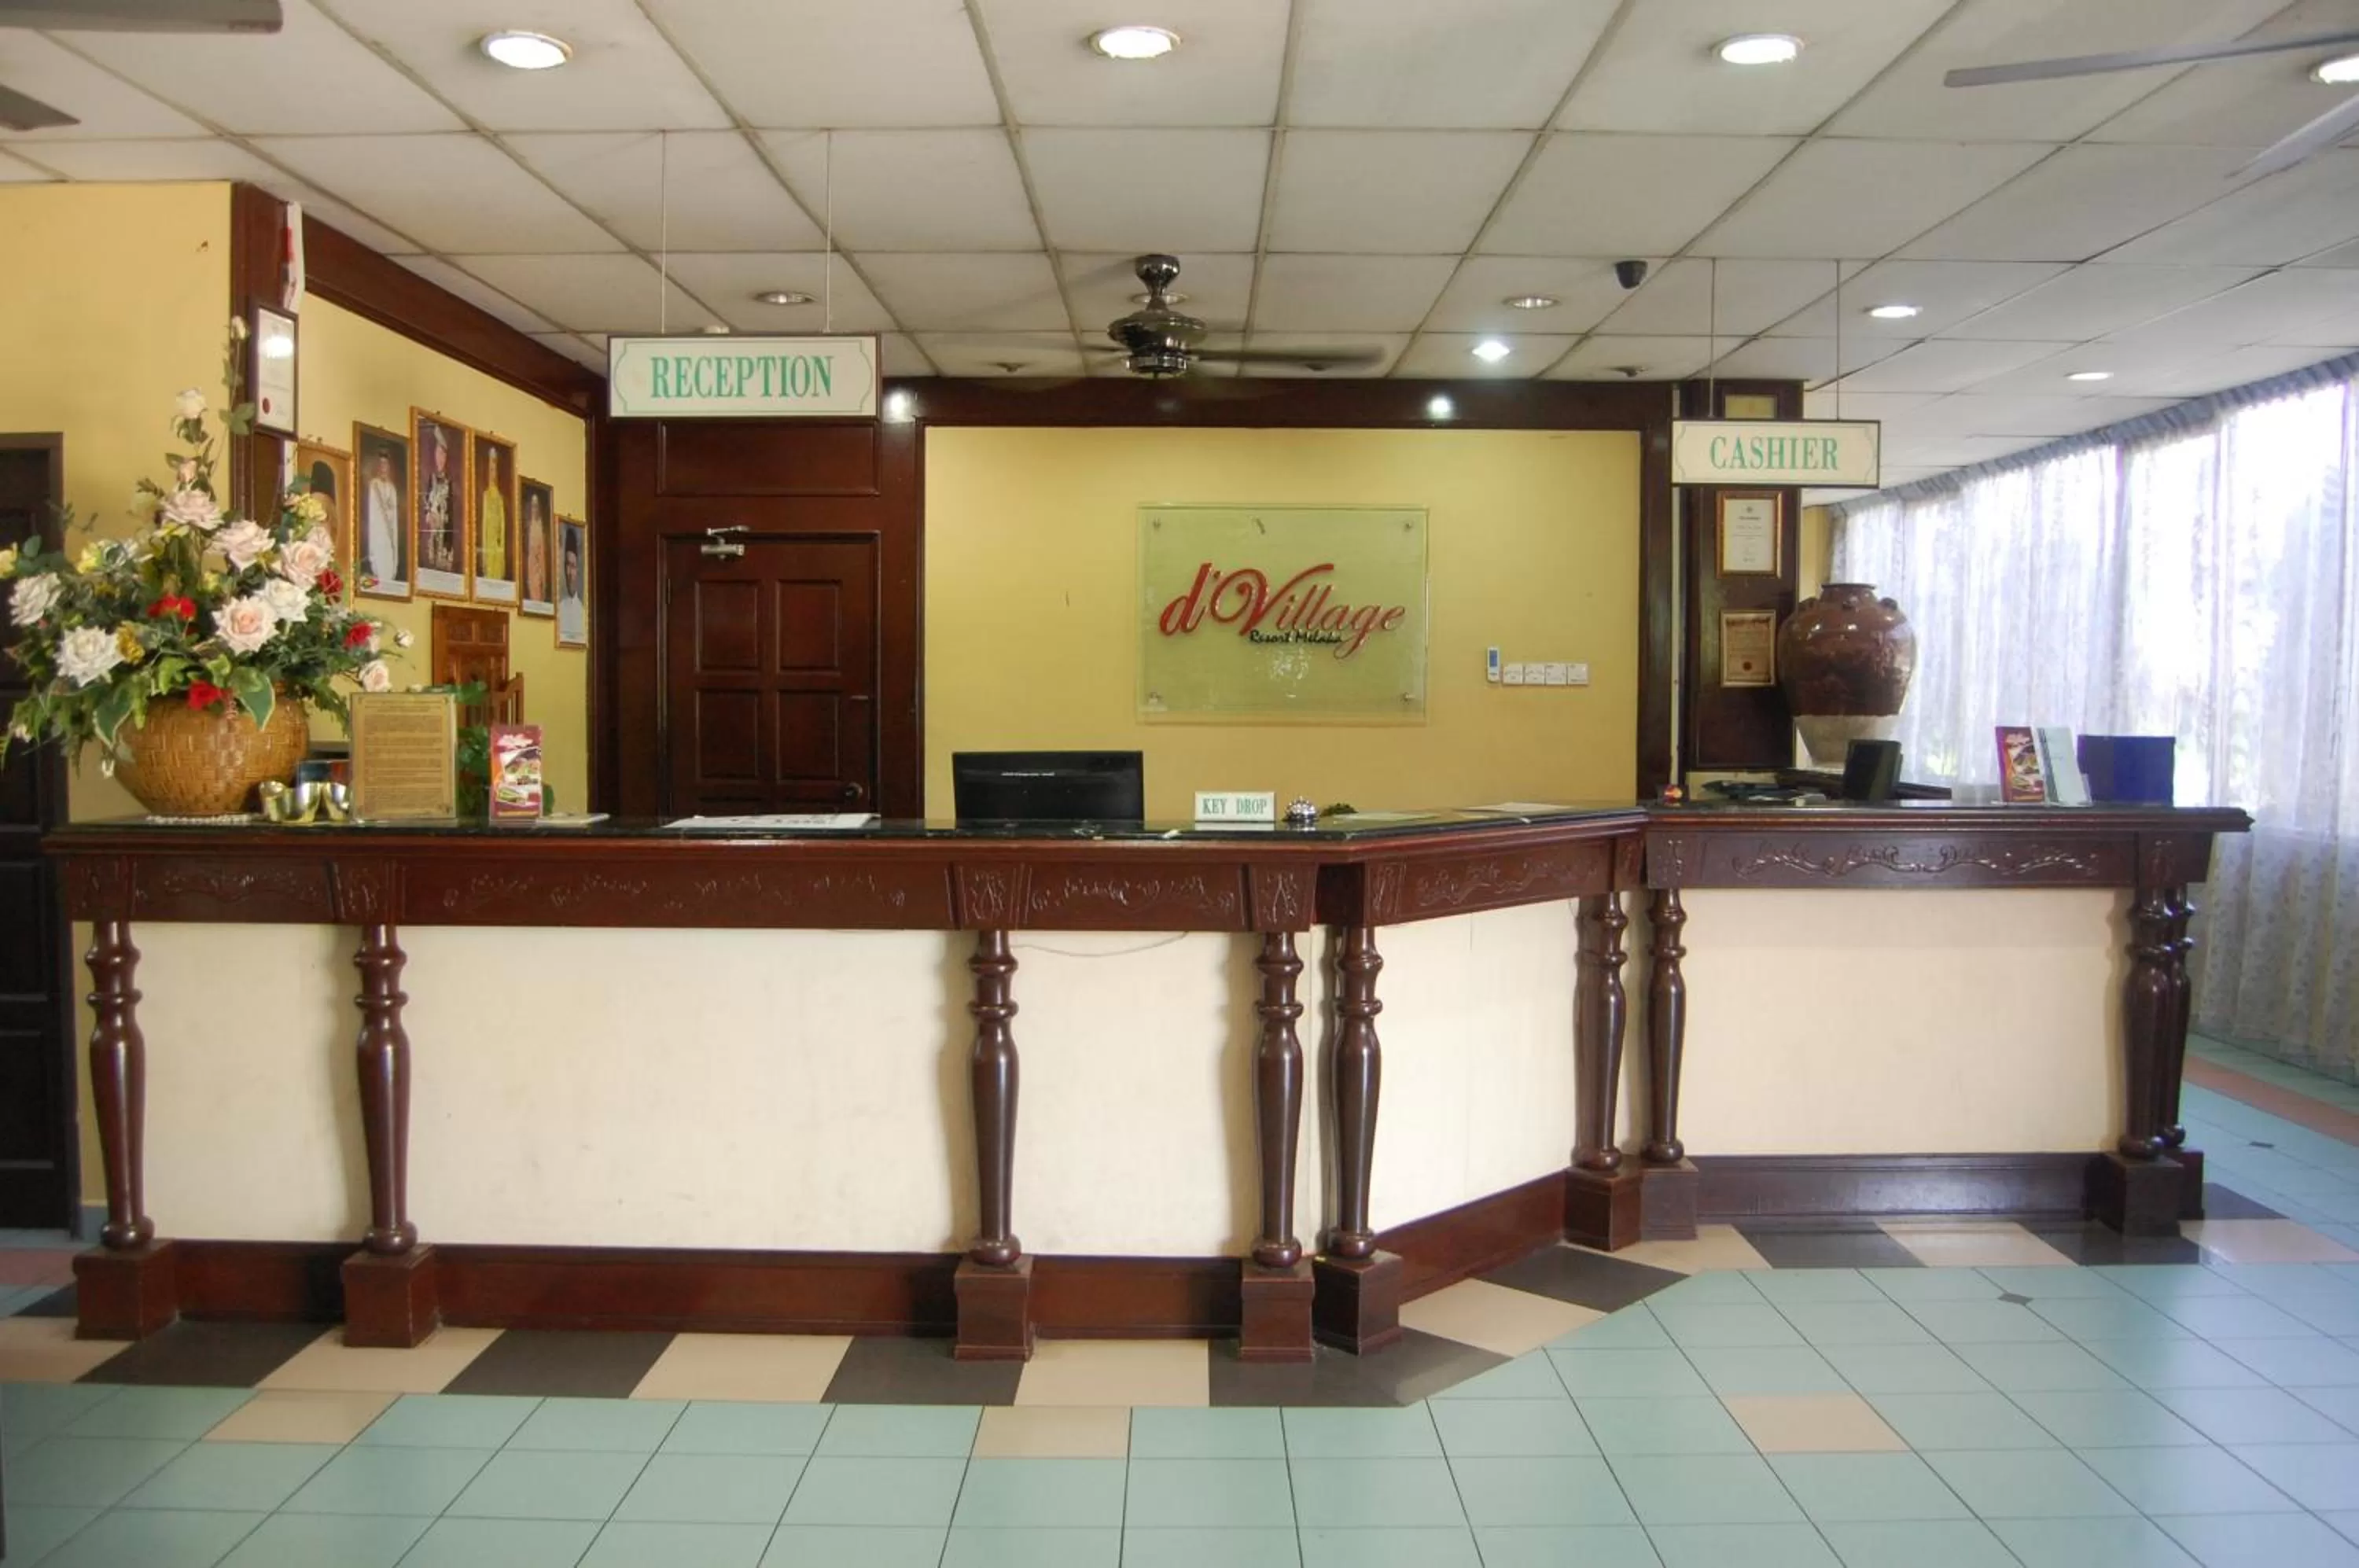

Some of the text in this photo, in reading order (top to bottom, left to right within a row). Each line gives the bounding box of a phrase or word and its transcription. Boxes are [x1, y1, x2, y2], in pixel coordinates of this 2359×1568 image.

[650, 355, 834, 398] RECEPTION
[1709, 436, 1838, 470] CASHIER
[1249, 628, 1292, 644] Resort
[1202, 797, 1268, 815] KEY DROP
